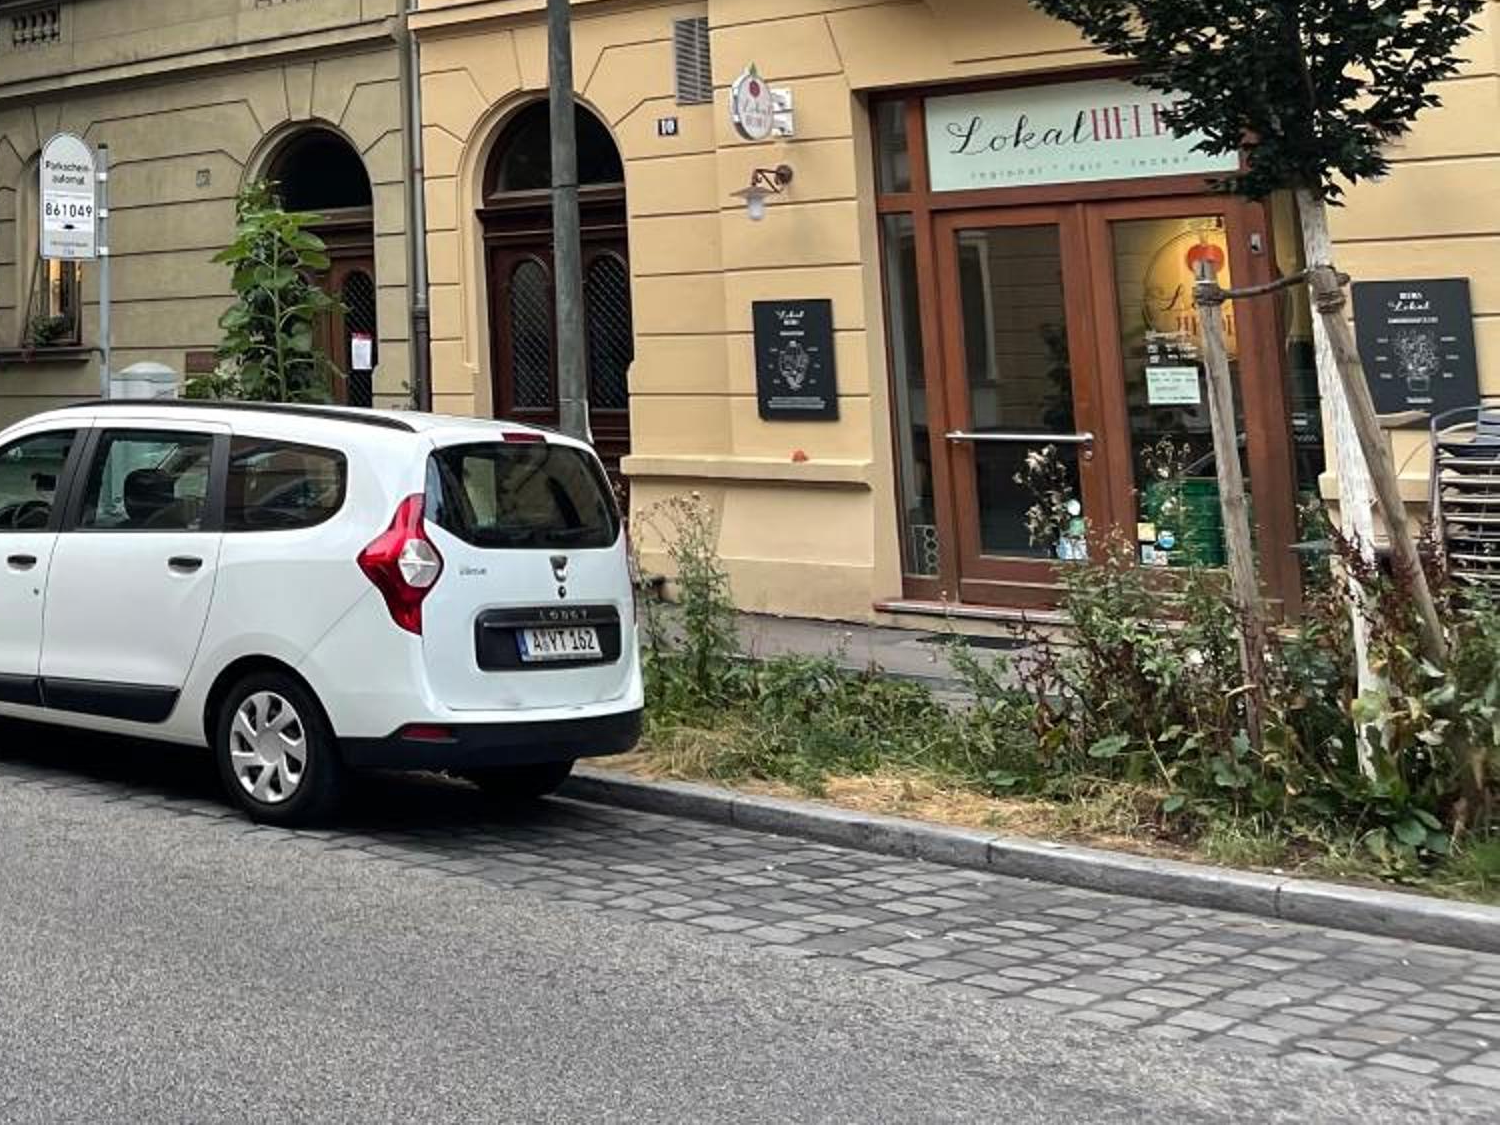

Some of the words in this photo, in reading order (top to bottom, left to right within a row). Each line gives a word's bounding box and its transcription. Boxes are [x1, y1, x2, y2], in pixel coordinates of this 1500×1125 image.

[45, 202, 93, 217] 861049
[549, 631, 567, 651] YT
[569, 630, 596, 650] 162
